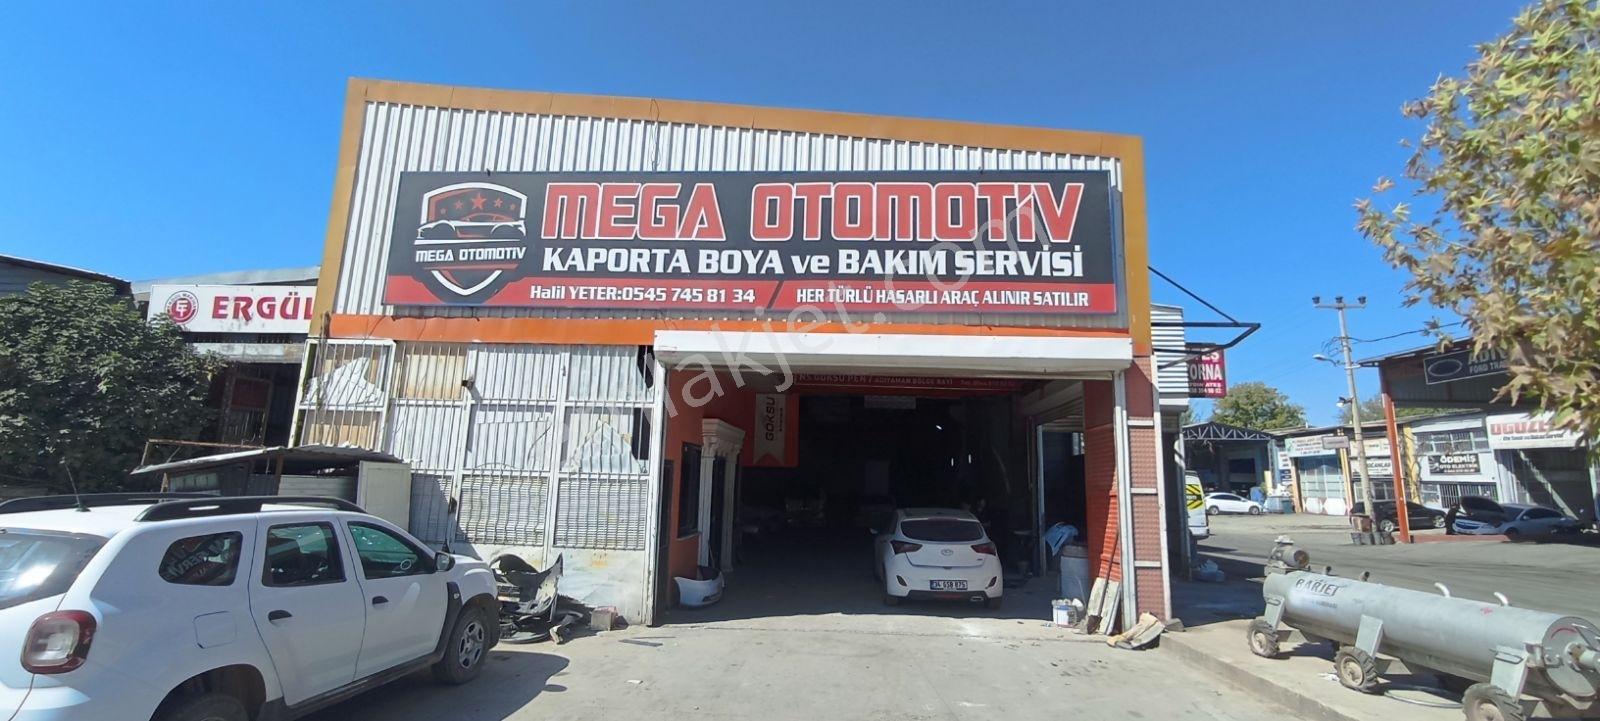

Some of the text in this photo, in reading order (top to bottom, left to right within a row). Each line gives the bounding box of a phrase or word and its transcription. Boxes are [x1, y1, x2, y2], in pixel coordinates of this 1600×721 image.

[541, 182, 726, 241] MEGA
[416, 249, 455, 263] MEGA
[542, 244, 1084, 277] KAPORTA BOYA ve BAKIM SERVİSİ
[530, 285, 566, 300] Halil
[671, 287, 703, 302] 745
[707, 288, 727, 303] 81
[732, 288, 755, 304] 34
[796, 285, 1089, 308] HER TÜRLÜ HASARLI ARAÇ ALINIR SATILIR
[1188, 363, 1223, 380] ORNA
